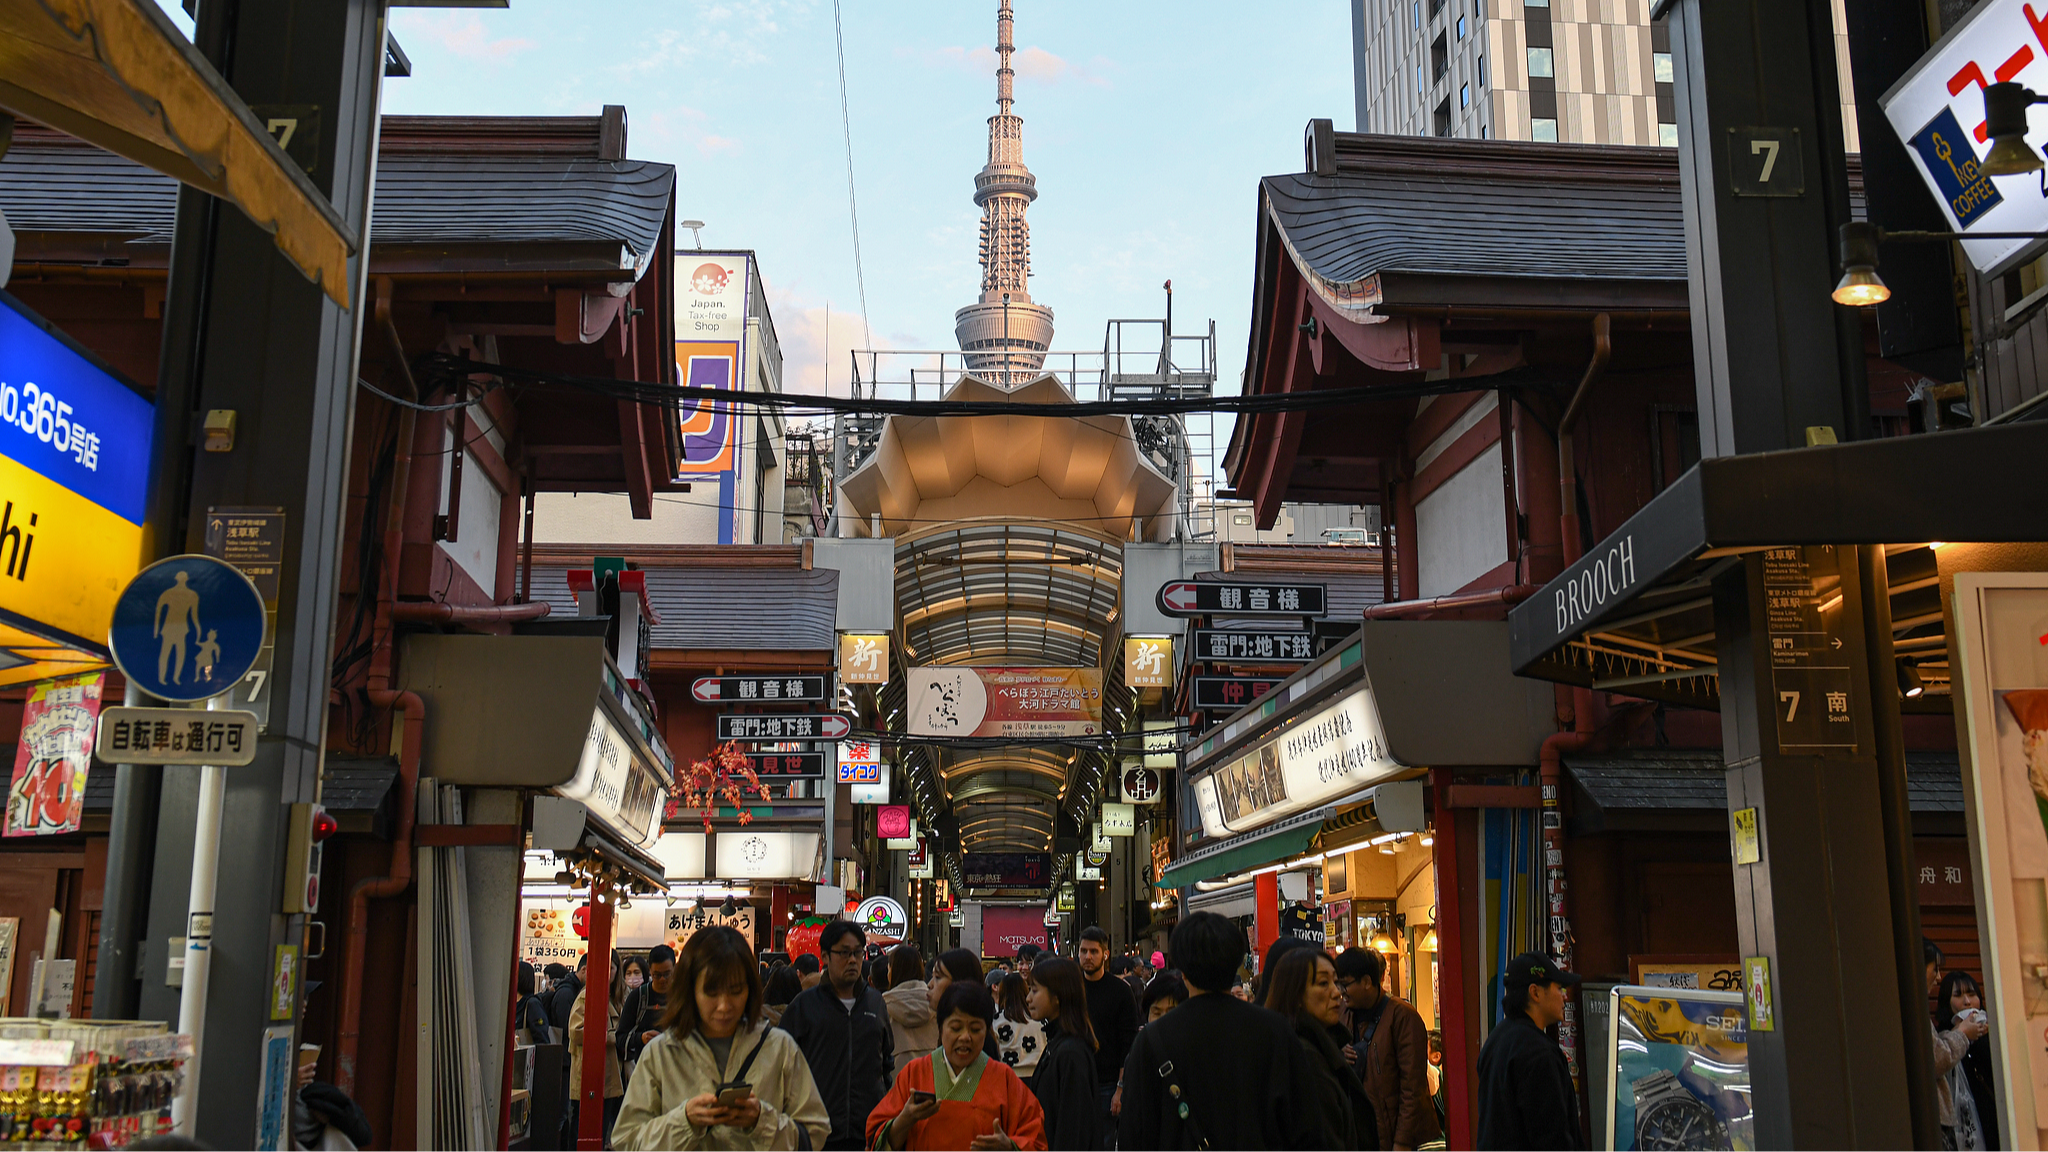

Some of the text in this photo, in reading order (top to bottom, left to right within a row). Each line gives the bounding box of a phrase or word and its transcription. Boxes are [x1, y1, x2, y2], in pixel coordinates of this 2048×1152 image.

[267, 118, 298, 150] 7
[1751, 140, 1780, 183] 7
[1958, 155, 1980, 187] KEY
[1953, 176, 1995, 218] COFFEE
[690, 299, 726, 309] Japan.
[687, 310, 728, 320] Tax-free
[694, 321, 720, 333] Shop
[226, 527, 260, 537] 浅草駅
[1764, 549, 1796, 560] 浅草駅
[1555, 535, 1636, 634] BROOCH
[1219, 586, 1300, 610] 観音様
[1769, 597, 1801, 608] 浅草駅
[1210, 635, 1312, 658] 雷門:地下鉄
[1772, 638, 1794, 649] 雷門
[848, 638, 882, 671] 新
[1132, 641, 1166, 675] 新
[245, 671, 267, 702] 7
[738, 680, 804, 698] 観音様
[998, 687, 1099, 699] べらぼう江戸たいとう
[1019, 699, 1081, 710] 大河ドラマ館
[1780, 691, 1800, 722] 7
[1825, 691, 1847, 712] 南
[112, 720, 244, 752] 自転車は通行可
[730, 718, 812, 736] 雷門:地下鉄
[840, 764, 879, 780] ダイコク
[1919, 866, 1962, 884] 舟和
[1292, 928, 1324, 943] TOKYO
[528, 947, 576, 957] 1袋350円
[1721, 1034, 1740, 1042] SINCE
